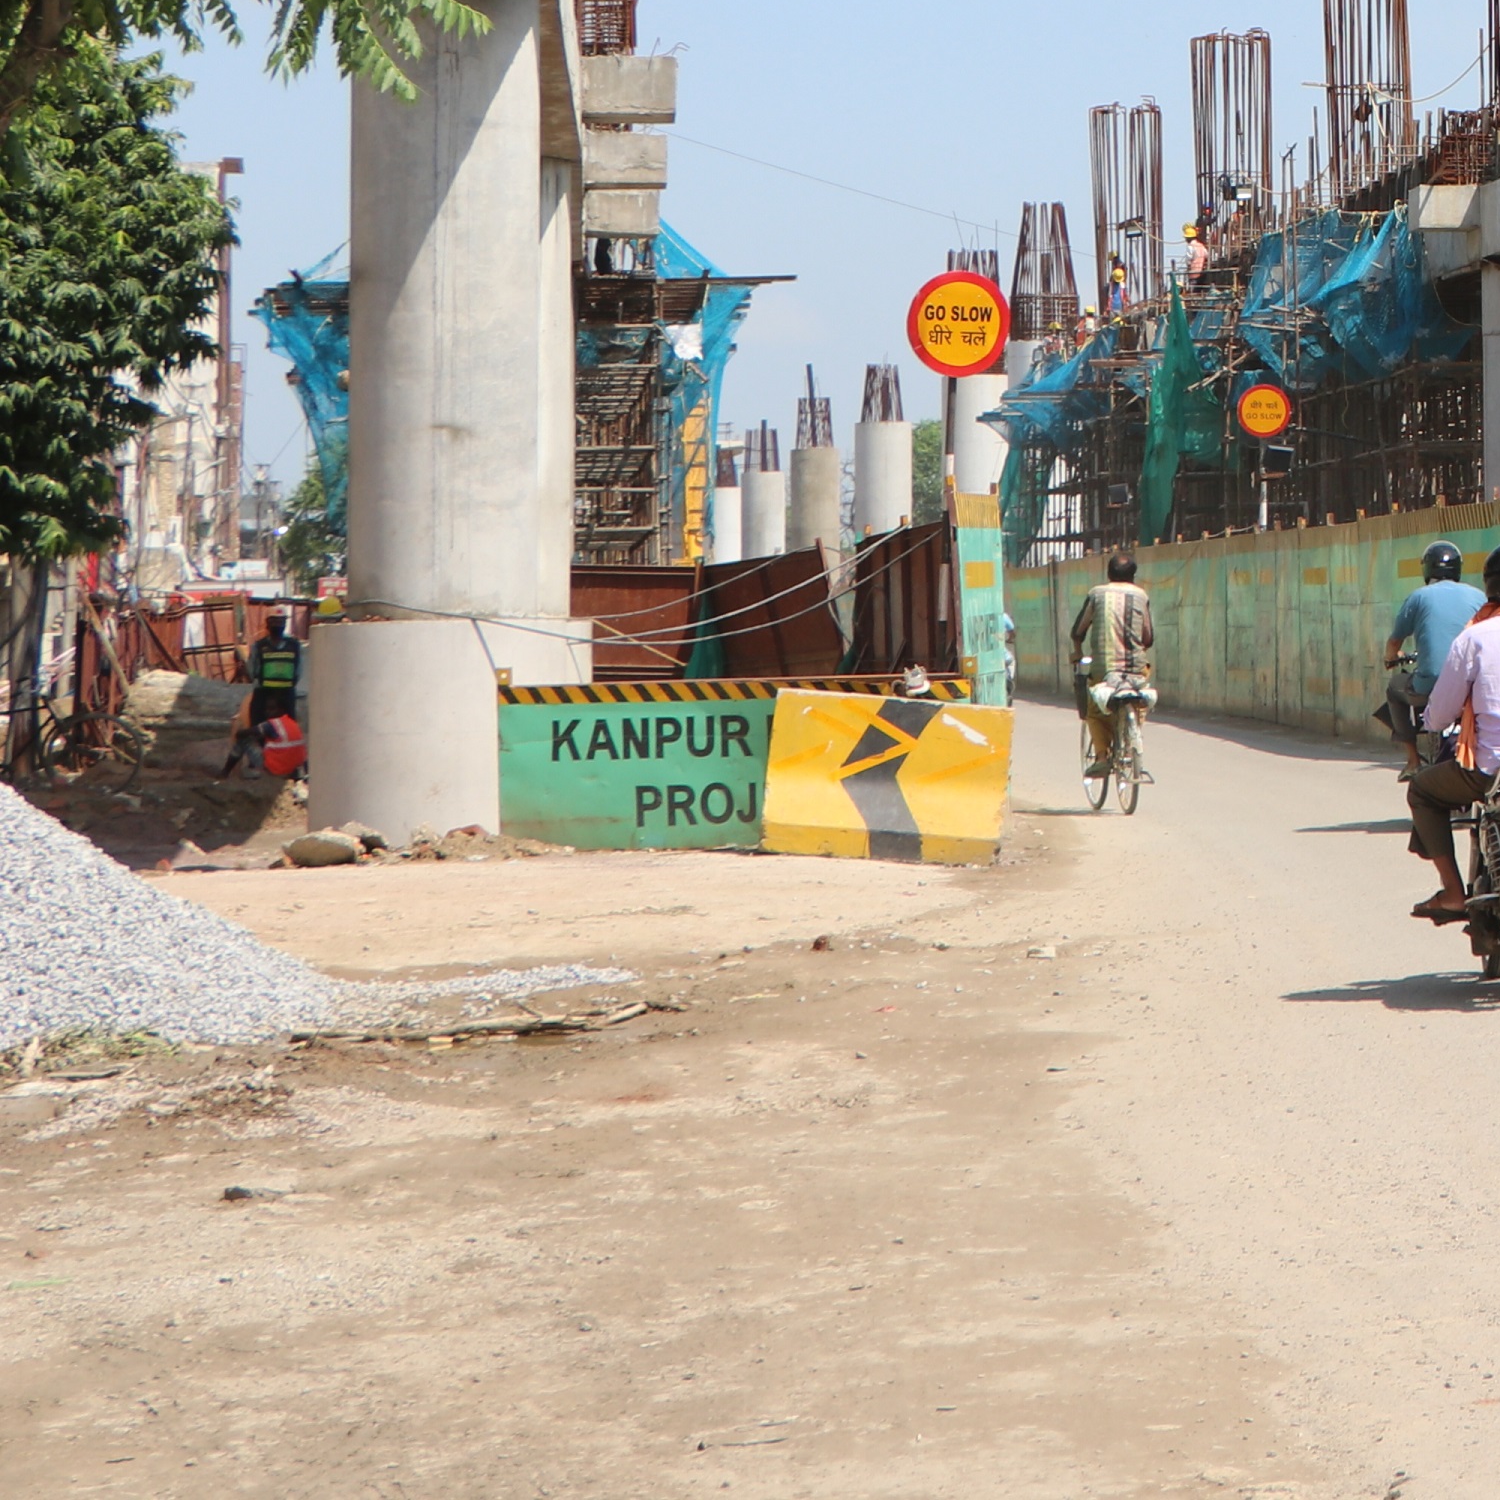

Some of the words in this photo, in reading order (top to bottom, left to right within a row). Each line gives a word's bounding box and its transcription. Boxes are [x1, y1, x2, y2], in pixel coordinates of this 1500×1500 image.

[924, 304, 946, 321] GO
[951, 306, 993, 322] SLOW
[928, 324, 953, 345] धीरे
[959, 326, 987, 346] चलें
[1245, 412, 1258, 420] GO
[551, 714, 753, 762] KANPUR
[635, 782, 757, 827] PROJ
